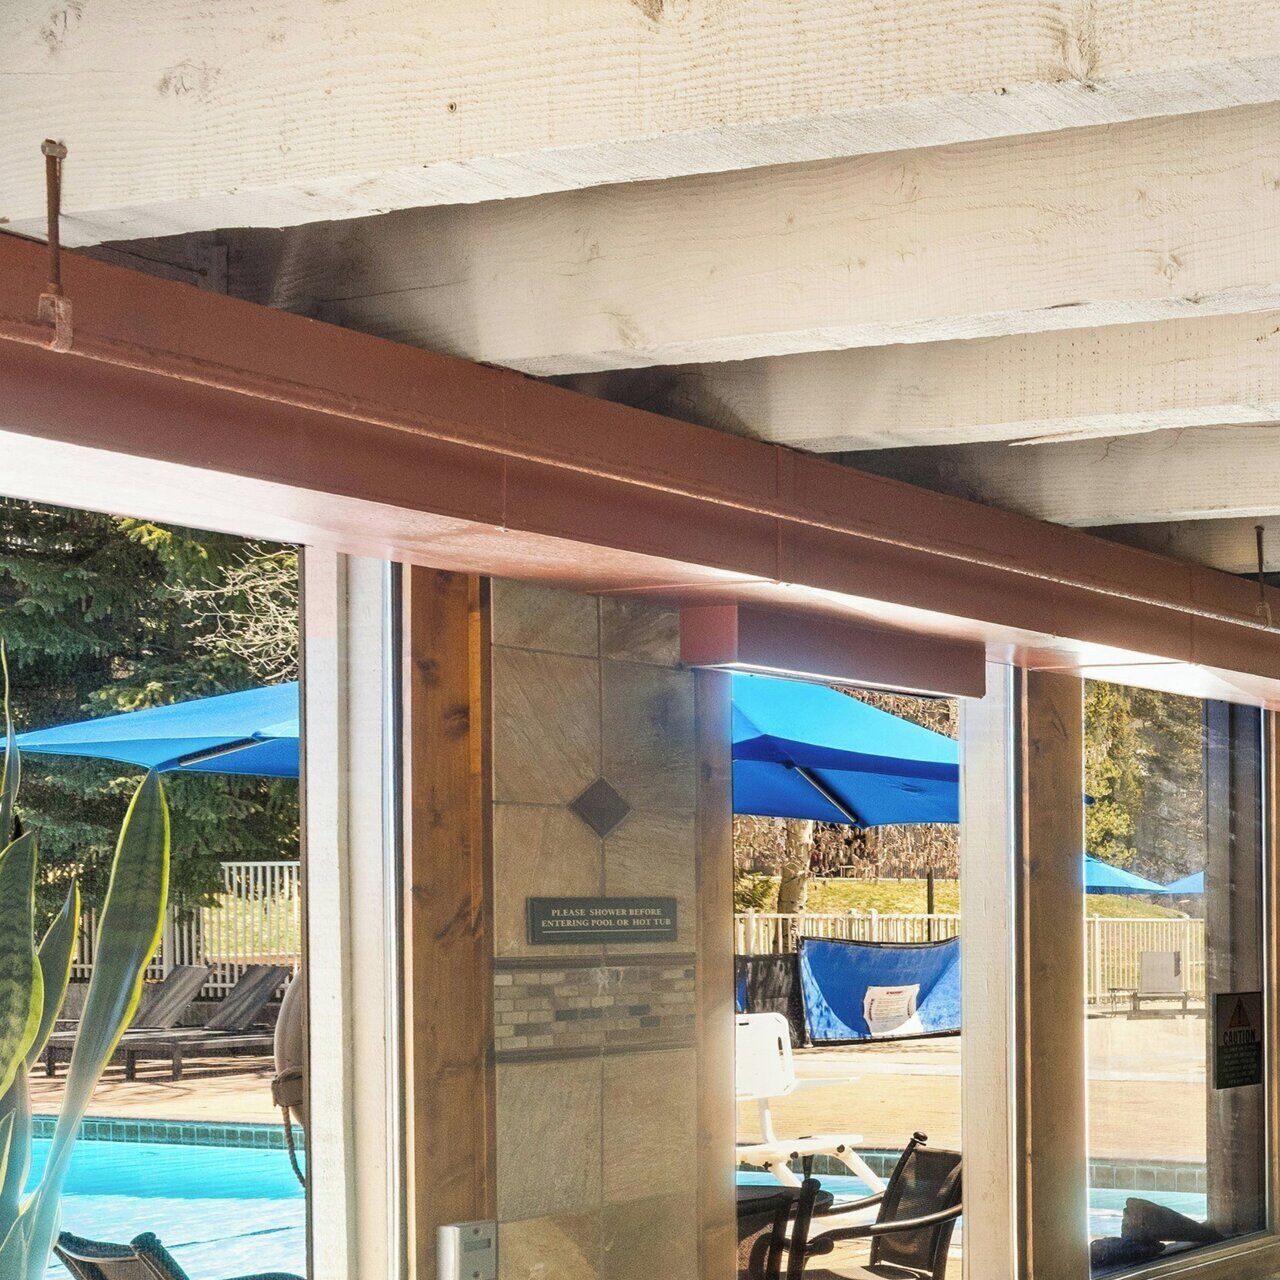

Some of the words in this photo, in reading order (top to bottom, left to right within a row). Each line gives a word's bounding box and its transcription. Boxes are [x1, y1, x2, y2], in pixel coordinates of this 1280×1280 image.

[551, 908, 586, 917] PLEASE
[589, 908, 628, 916] SHOWER
[628, 907, 662, 916] BEFORE
[541, 919, 589, 927] ENTERING
[591, 919, 614, 927] POOL
[632, 918, 651, 926] HOT
[653, 918, 672, 926] TUB
[1223, 1029, 1256, 1046] CAUTION
